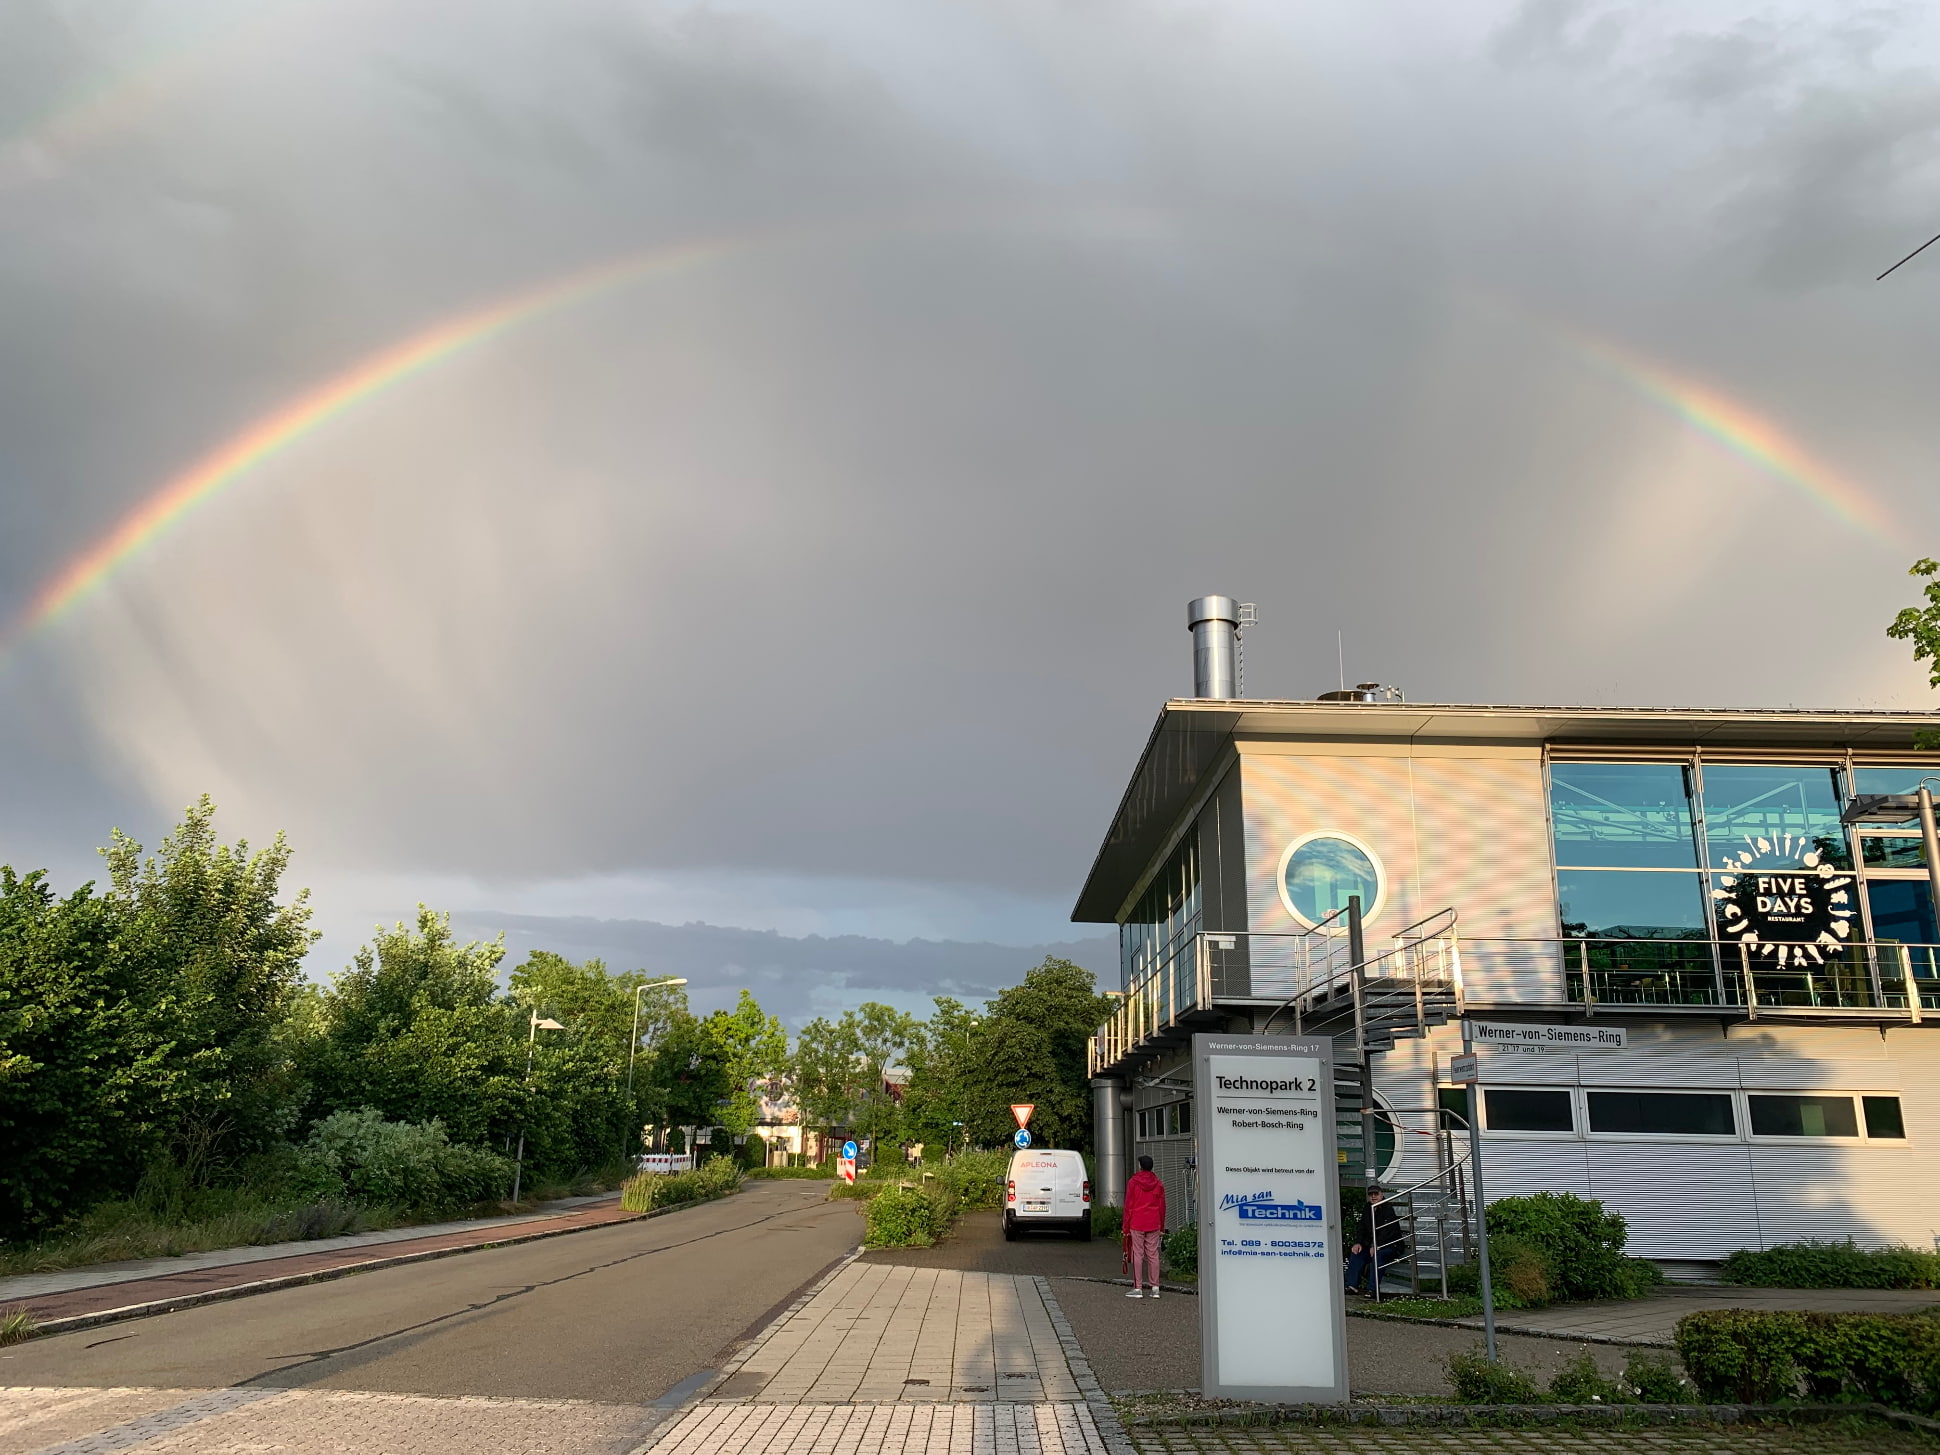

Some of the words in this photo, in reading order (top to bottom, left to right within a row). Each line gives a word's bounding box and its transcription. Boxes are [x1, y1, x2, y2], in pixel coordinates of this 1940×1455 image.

[1758, 877, 1807, 894] FIVE
[1757, 896, 1814, 914] DAYS
[1478, 1024, 1622, 1047] Werner-von-Siemens-Ring
[1208, 1041, 1308, 1052] Werner-von-Siemens-Ring
[1310, 1044, 1320, 1052] 17
[1216, 1075, 1303, 1094] Technopark
[1307, 1078, 1317, 1092] 2
[1217, 1106, 1318, 1118] Werner-von-Siemens-Ring
[1232, 1120, 1304, 1130] Robert-Bosch-Ring
[1243, 1166, 1261, 1174] Objekt
[1219, 1193, 1248, 1209] Mia
[1252, 1190, 1272, 1201] san
[1243, 1205, 1317, 1219] Technik
[1221, 1249, 1325, 1258] info@mia-san-technik.de
